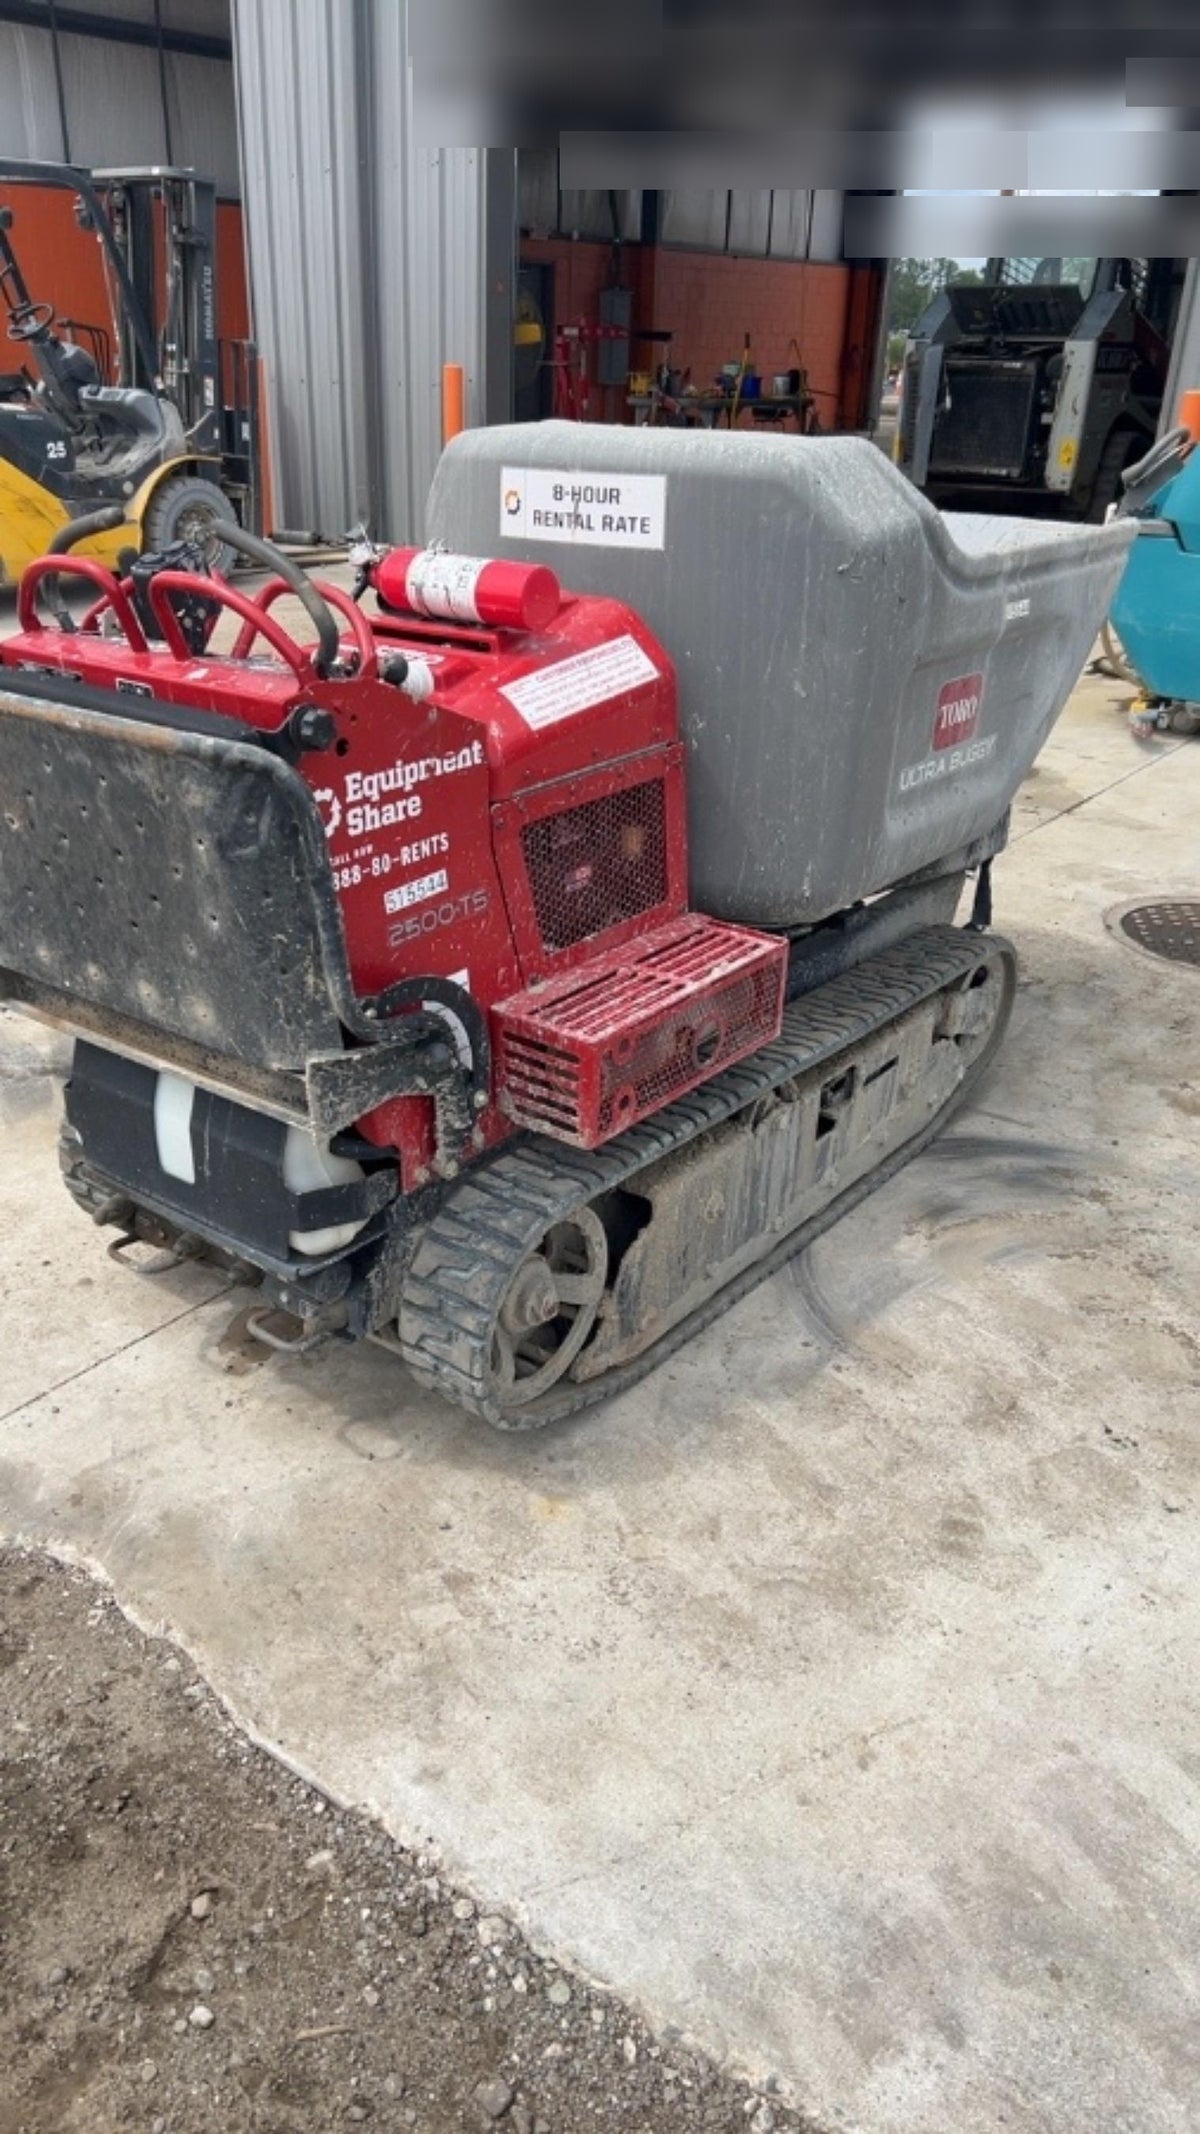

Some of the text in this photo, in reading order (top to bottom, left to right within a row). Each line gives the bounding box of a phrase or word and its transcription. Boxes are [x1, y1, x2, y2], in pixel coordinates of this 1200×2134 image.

[46, 441, 67, 459] 25
[552, 483, 621, 505] 8-HOUR
[532, 509, 651, 534] RENTAL RATE
[940, 694, 978, 729] TORO
[900, 733, 998, 791] ULTRA BUGGY
[346, 795, 423, 837] Share
